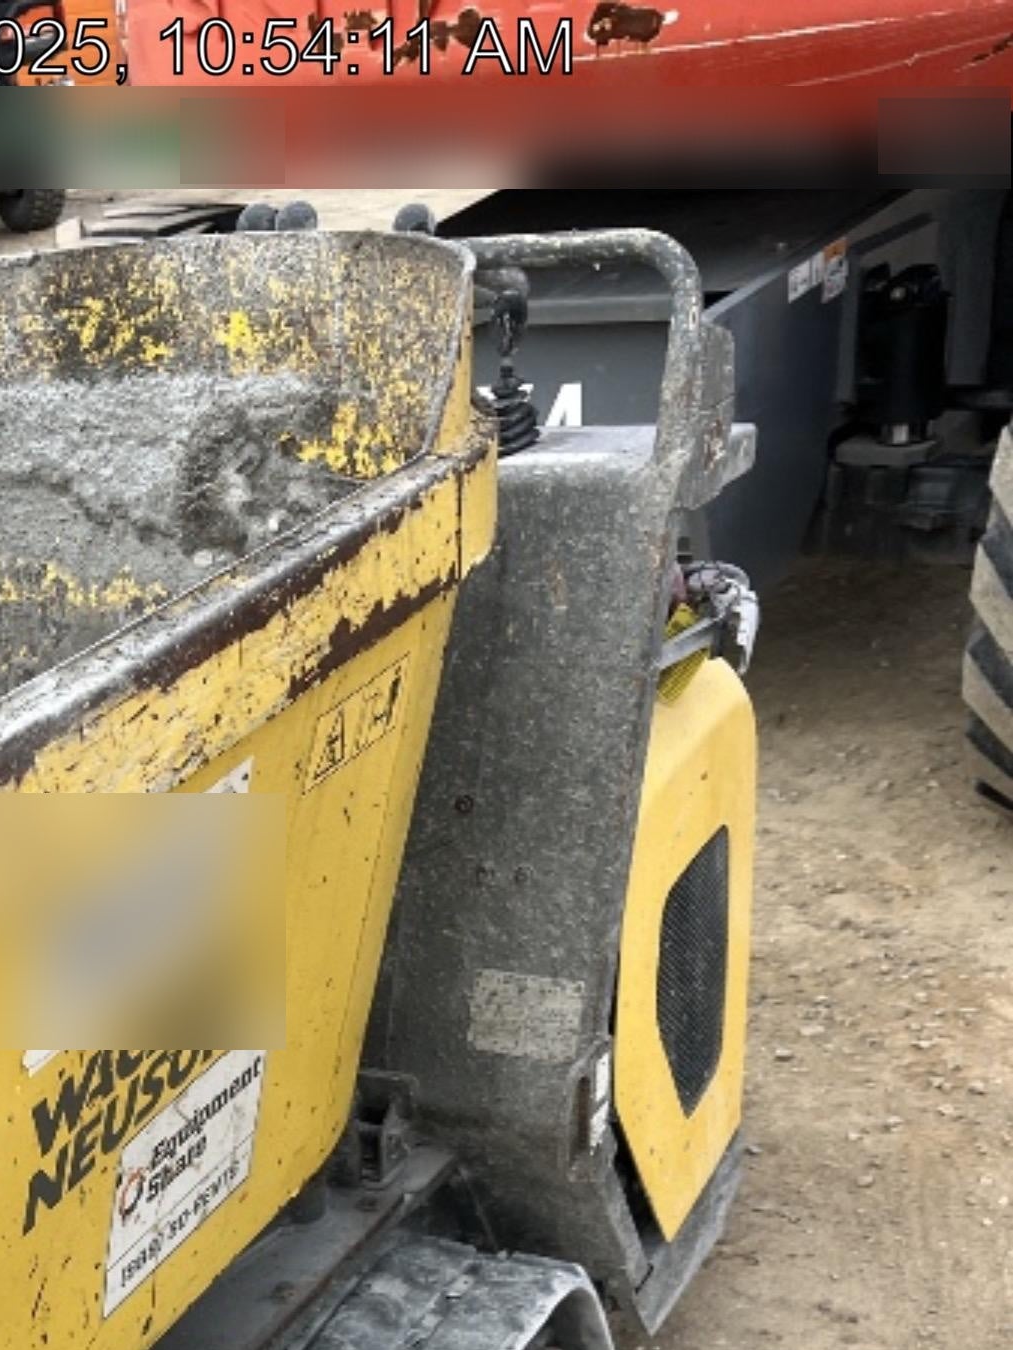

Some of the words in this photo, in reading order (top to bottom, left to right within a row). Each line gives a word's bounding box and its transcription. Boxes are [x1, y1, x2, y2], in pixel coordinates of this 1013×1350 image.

[22, 1050, 213, 1236] NEUSO
[152, 1056, 261, 1168] Equipment
[146, 1135, 207, 1203] Share
